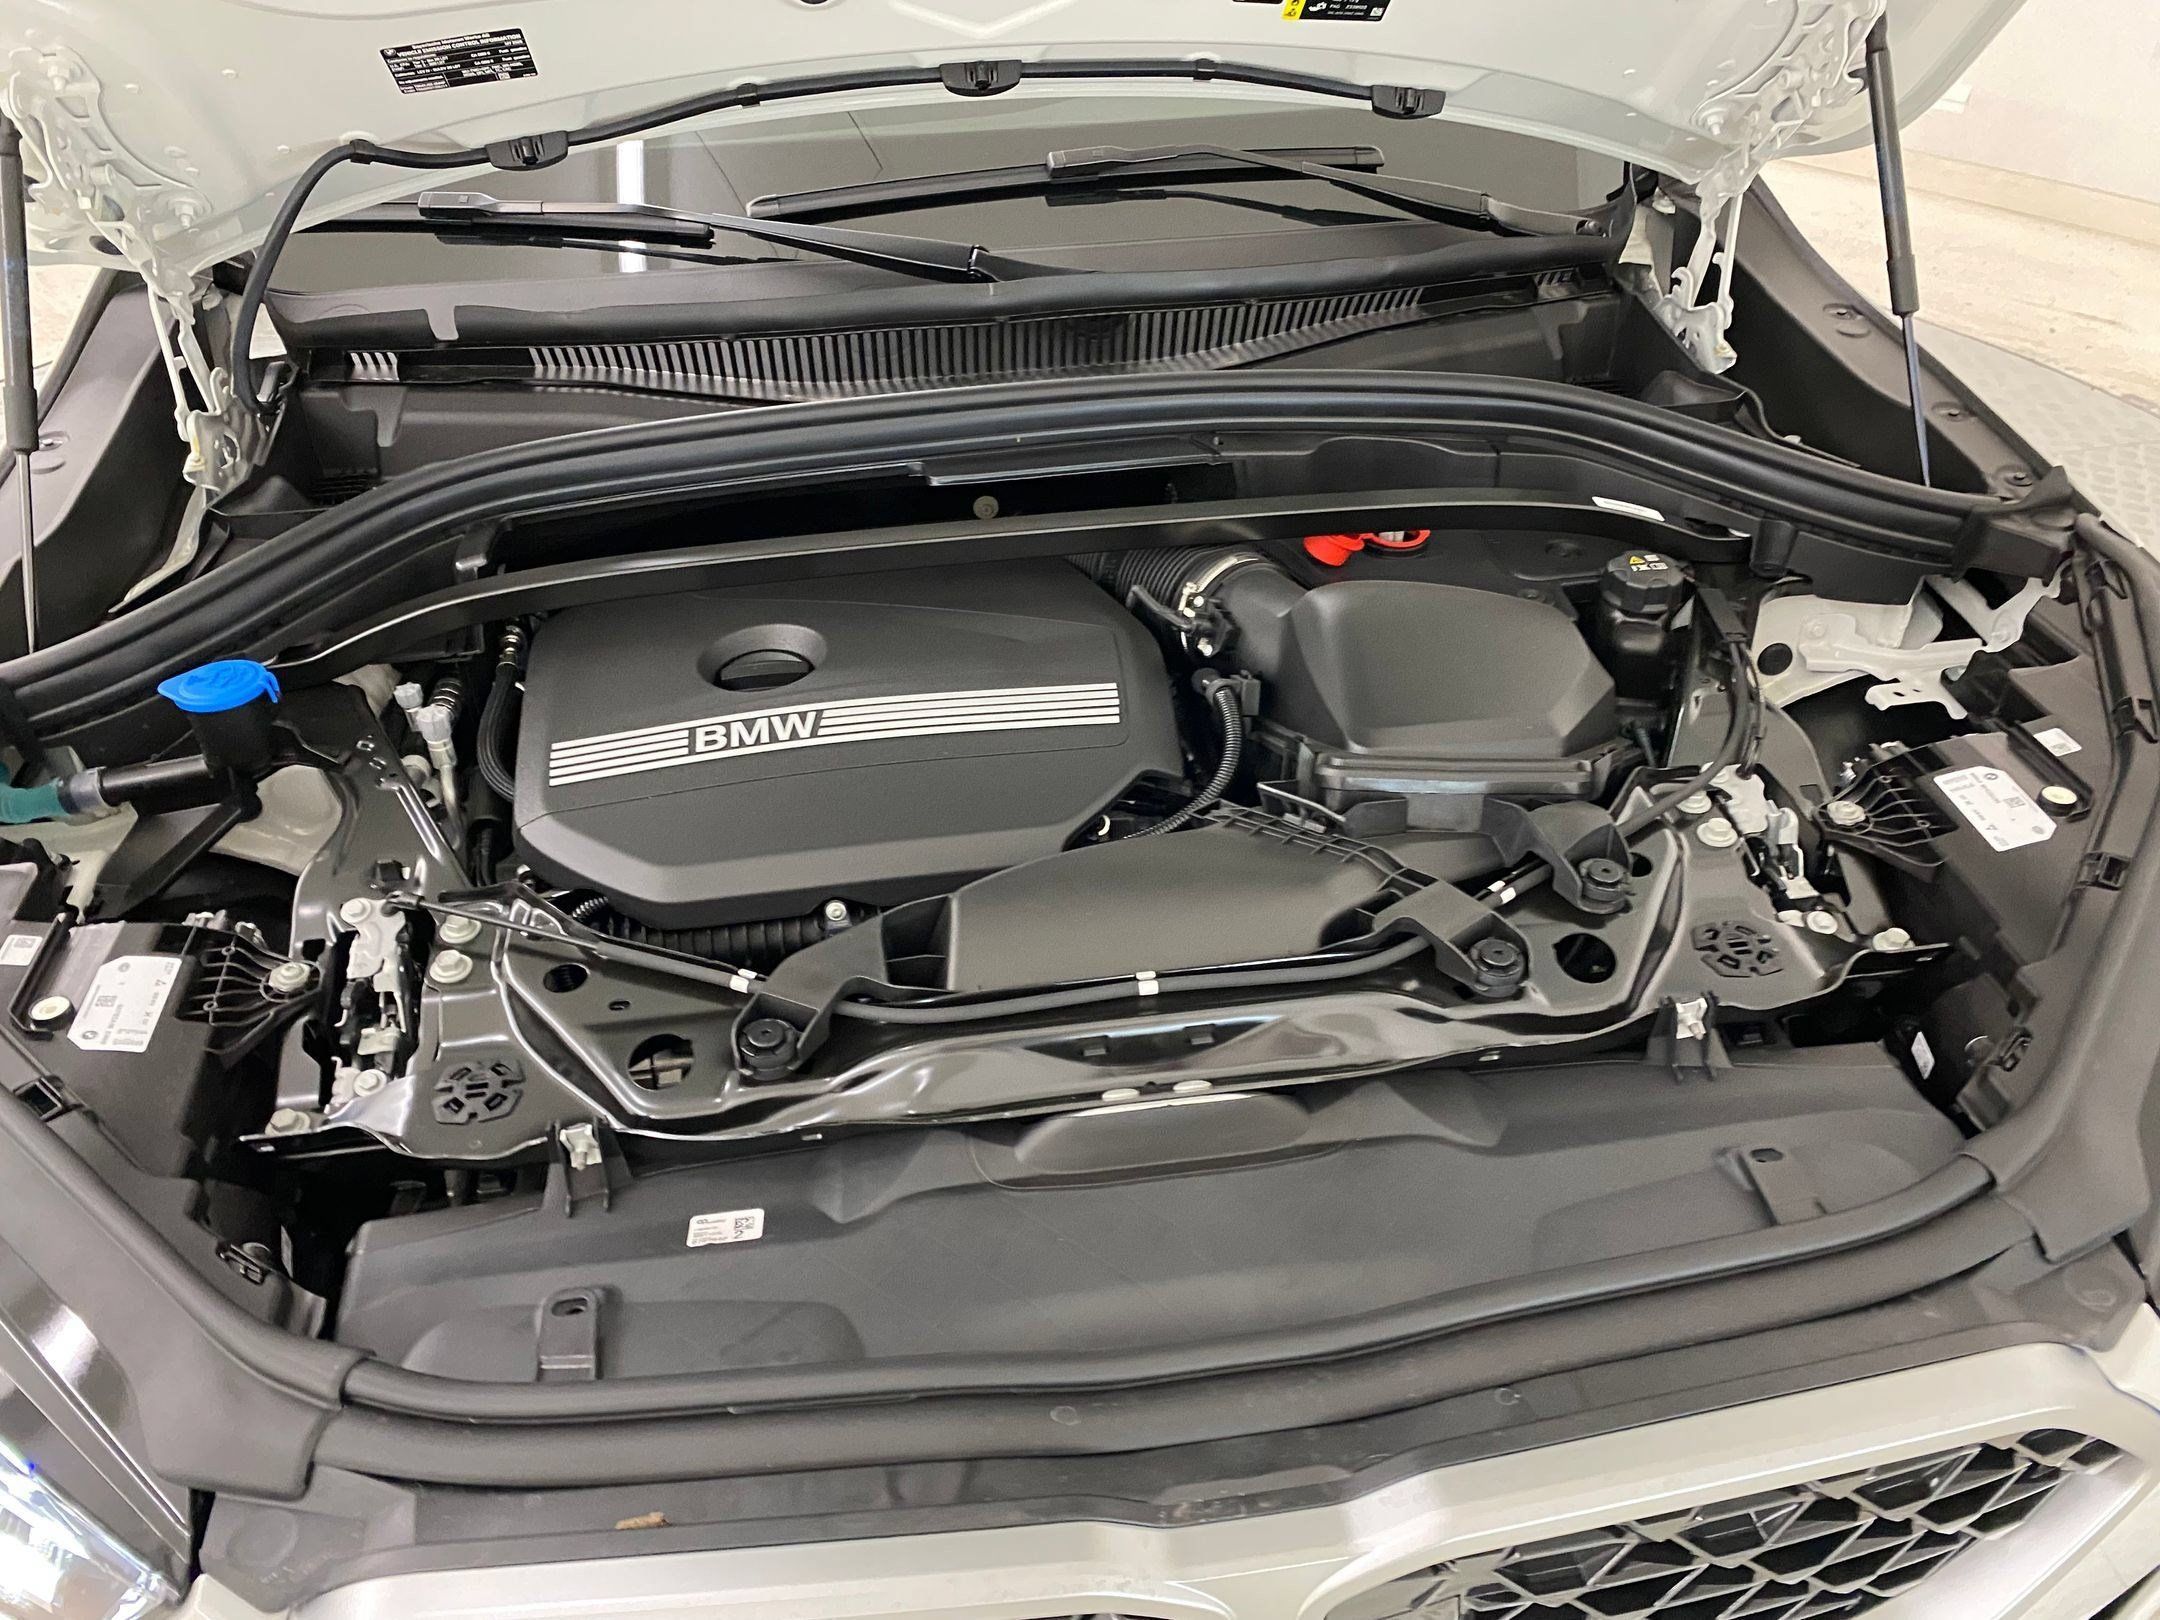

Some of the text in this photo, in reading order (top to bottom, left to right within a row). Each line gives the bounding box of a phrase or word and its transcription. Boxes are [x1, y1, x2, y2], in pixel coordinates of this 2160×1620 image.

[396, 49, 422, 57] VEHICLE
[451, 40, 480, 49] CONTROL
[480, 33, 521, 45] INFORMATION
[695, 711, 817, 753] BMW
